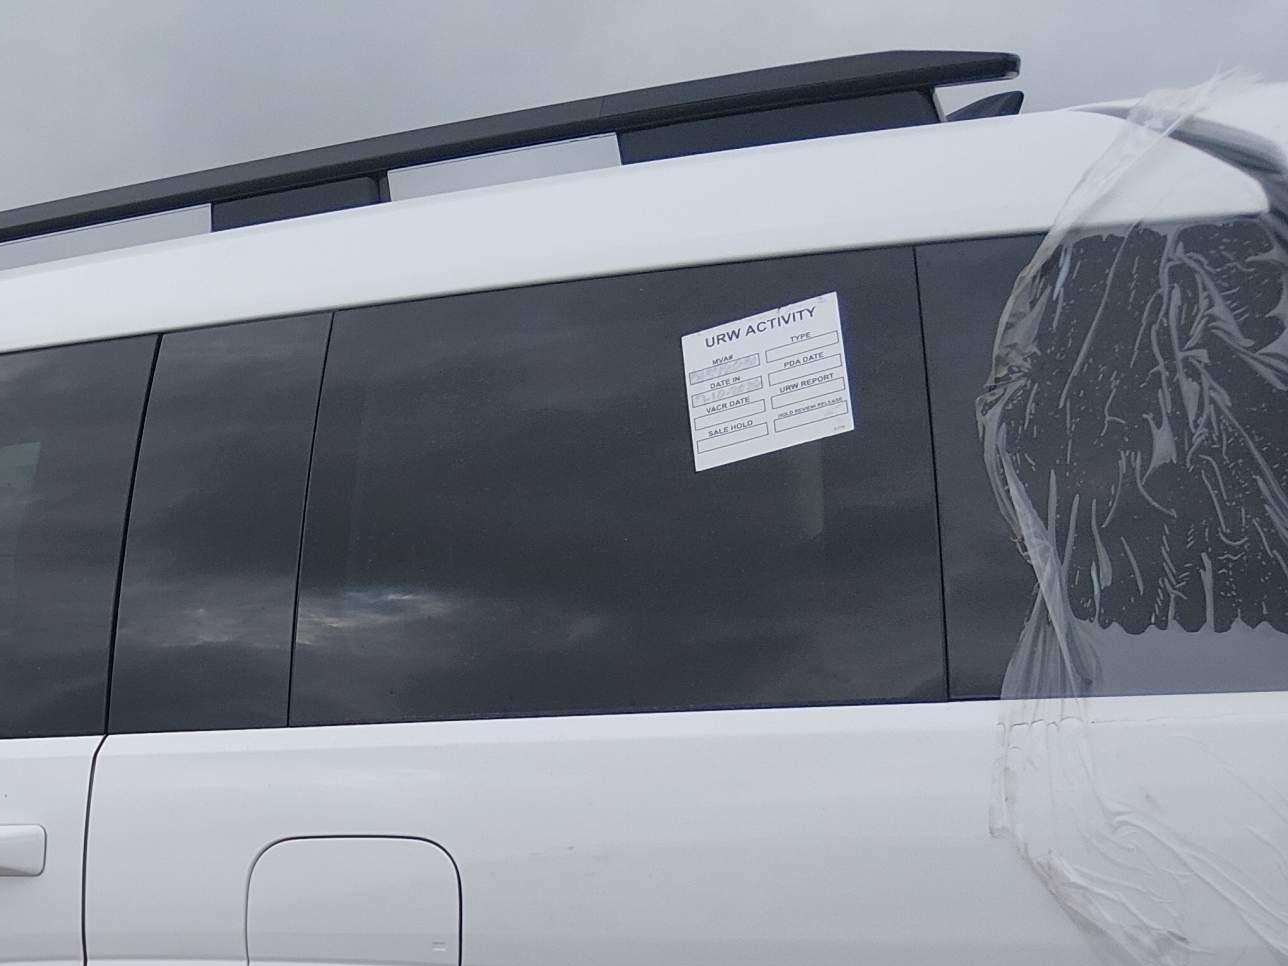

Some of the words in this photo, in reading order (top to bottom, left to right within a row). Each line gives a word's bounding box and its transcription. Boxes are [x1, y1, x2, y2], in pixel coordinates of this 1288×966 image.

[705, 328, 742, 348] URW
[745, 306, 816, 337] ACTIVITY
[790, 332, 811, 343] TYPE
[783, 359, 801, 369] PDA
[803, 352, 824, 364] DATE
[710, 378, 731, 389] DATE
[732, 376, 741, 384] IN
[779, 382, 799, 393] URW
[801, 373, 834, 388] REPORT
[729, 397, 751, 408] DATE
[708, 427, 730, 436] SALE
[731, 420, 753, 431] HOLD
